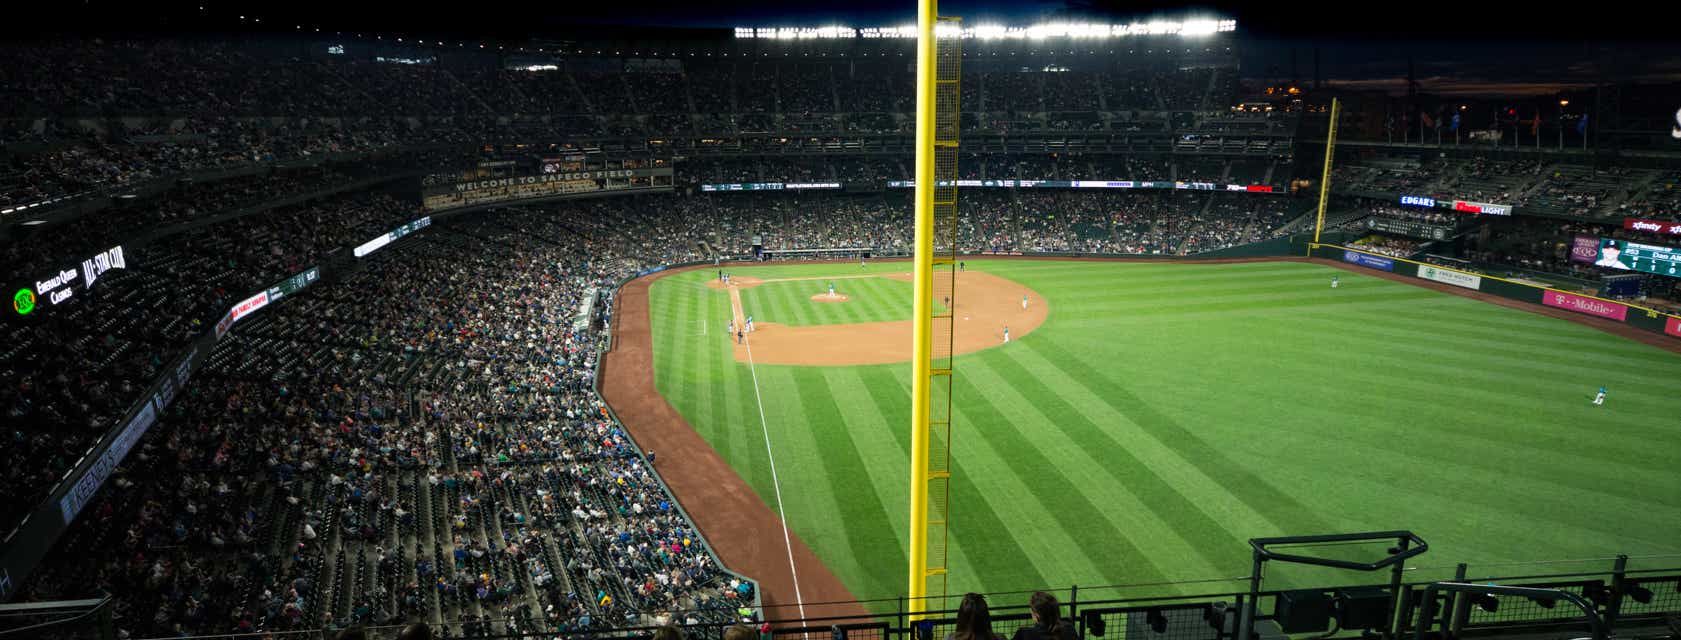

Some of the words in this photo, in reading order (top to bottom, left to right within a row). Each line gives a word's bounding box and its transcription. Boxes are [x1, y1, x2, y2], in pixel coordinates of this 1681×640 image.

[456, 178, 514, 191] WELCOME
[519, 176, 536, 185] TO
[541, 172, 590, 183] SAFECO
[597, 169, 633, 179] FIELD
[1481, 205, 1505, 215] LIGHT
[1632, 222, 1662, 232] xfinity
[1652, 251, 1669, 260] Dan
[83, 252, 111, 289] ALL-STAR
[109, 246, 125, 269] CLUB
